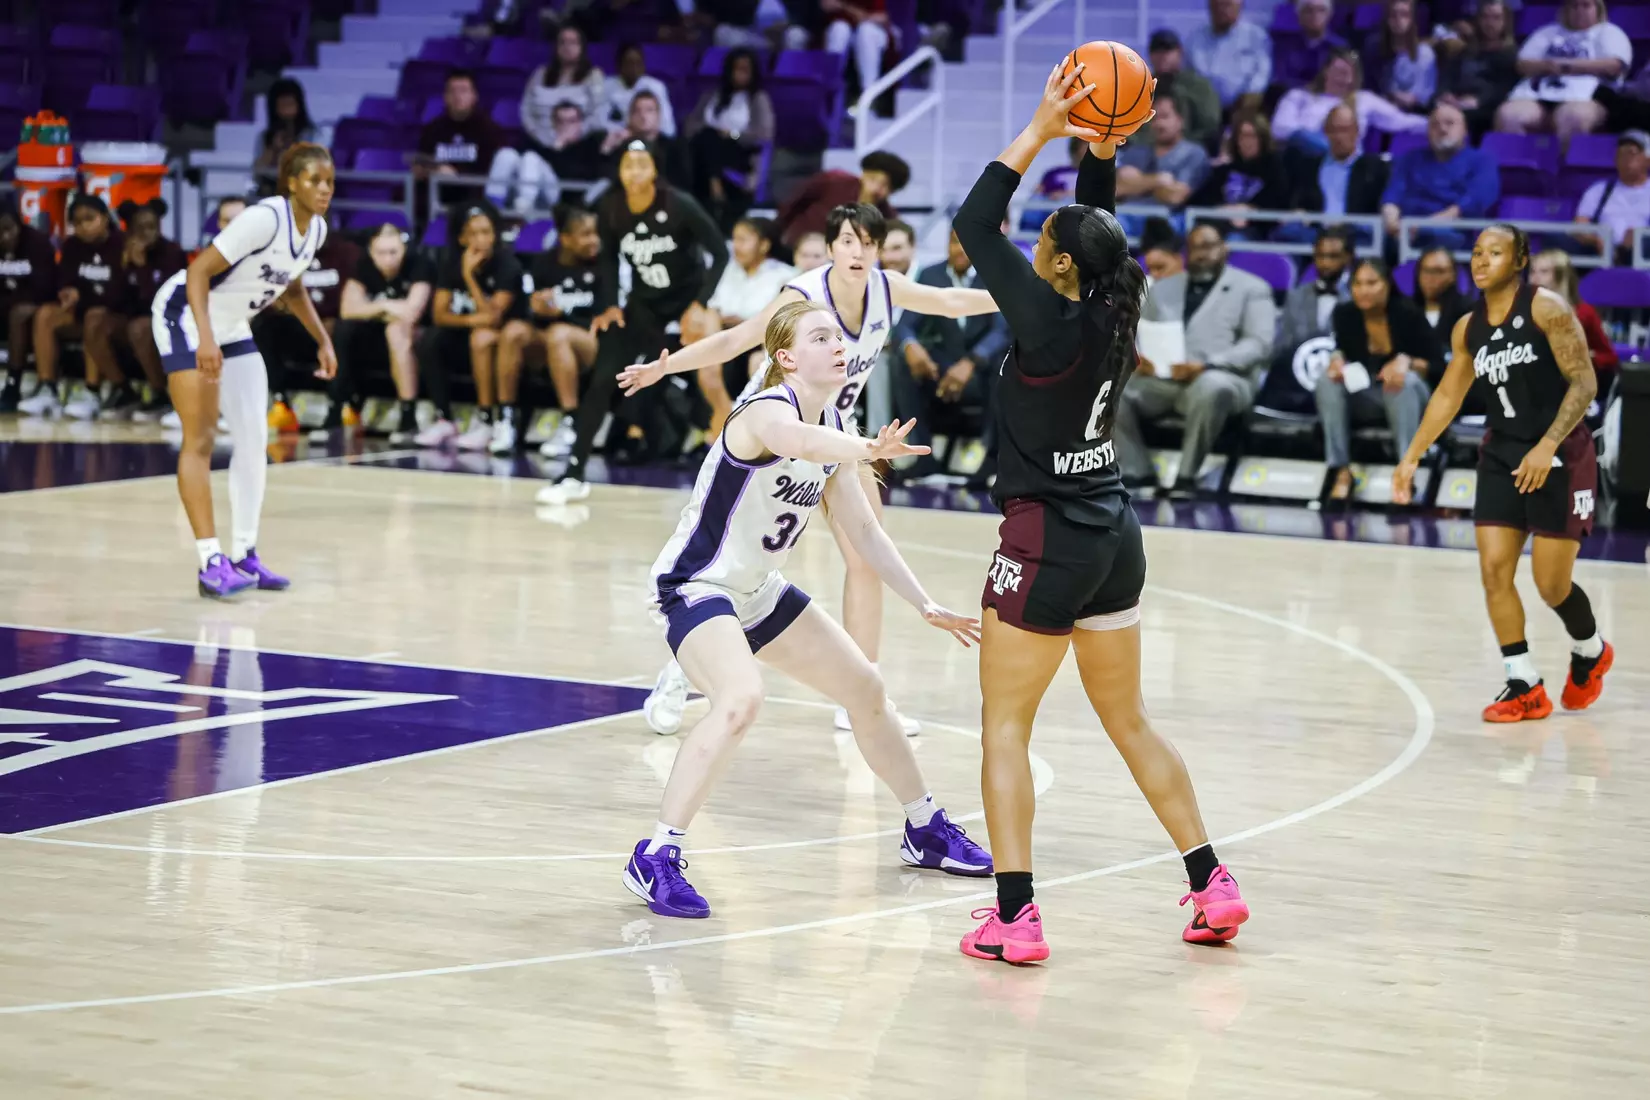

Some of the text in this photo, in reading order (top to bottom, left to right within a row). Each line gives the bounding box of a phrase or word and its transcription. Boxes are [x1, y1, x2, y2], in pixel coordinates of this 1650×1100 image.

[1473, 341, 1539, 386] Aggies
[835, 382, 860, 410] 6
[1496, 386, 1517, 418] 1
[761, 510, 811, 554] 3
